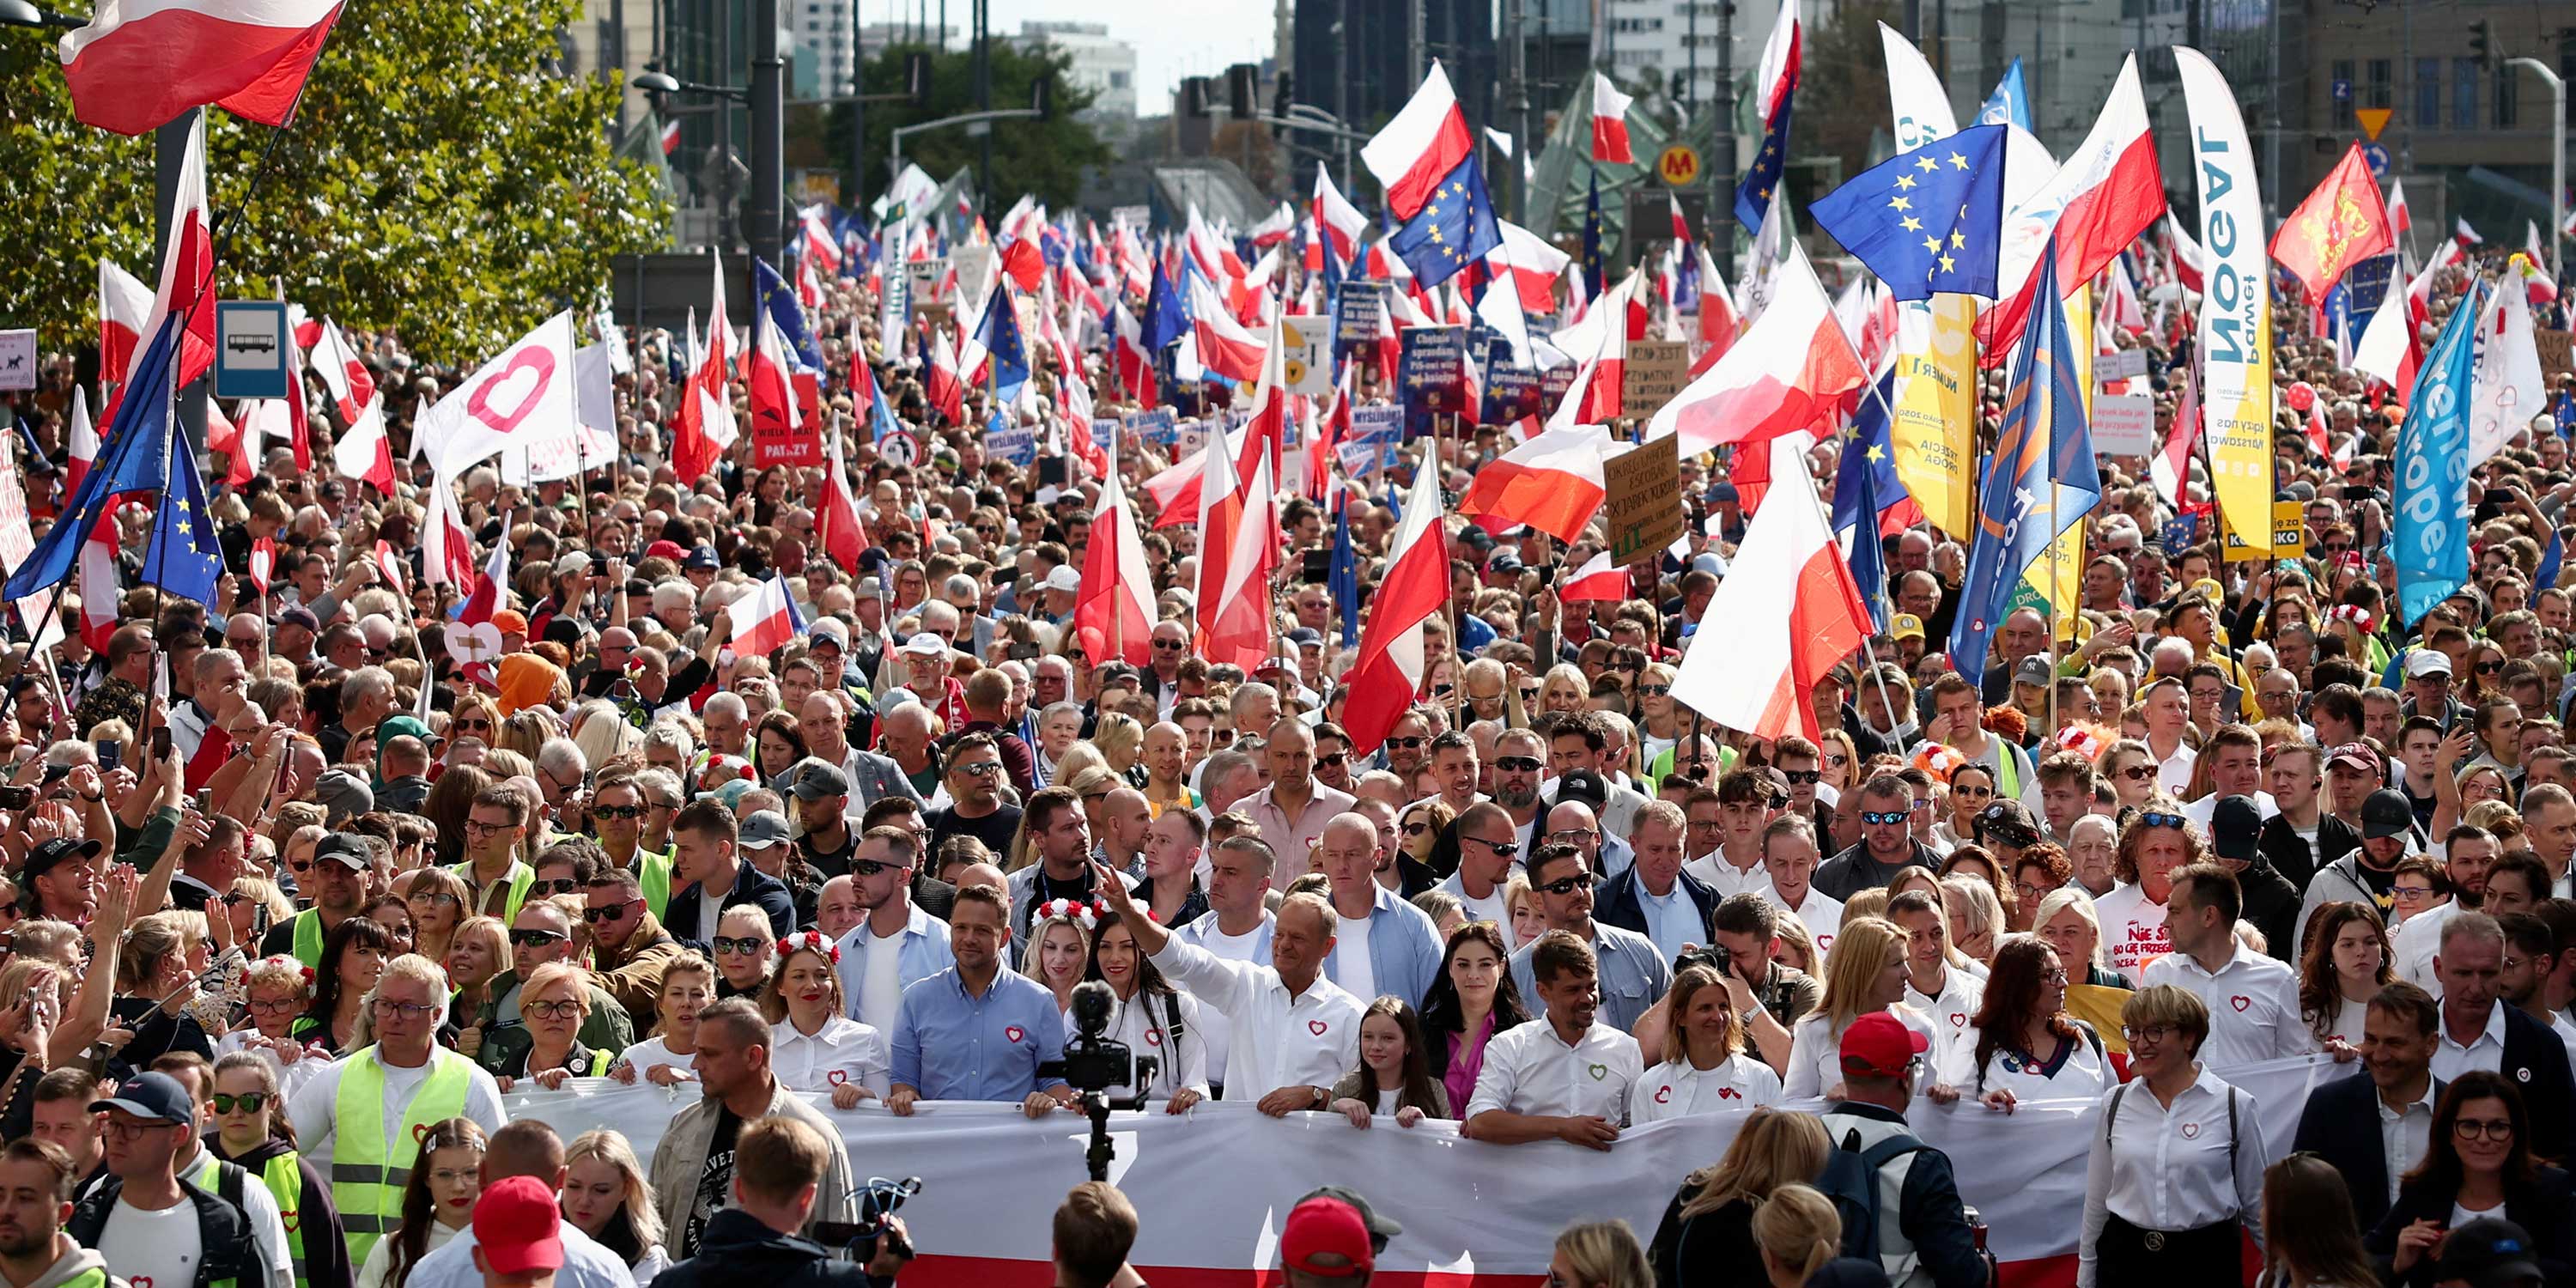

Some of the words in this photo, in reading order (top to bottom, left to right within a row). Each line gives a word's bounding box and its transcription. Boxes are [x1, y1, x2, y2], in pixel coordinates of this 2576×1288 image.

[1666, 151, 1692, 177] M
[2403, 404, 2447, 570] urope.
[2424, 339, 2470, 519] renew
